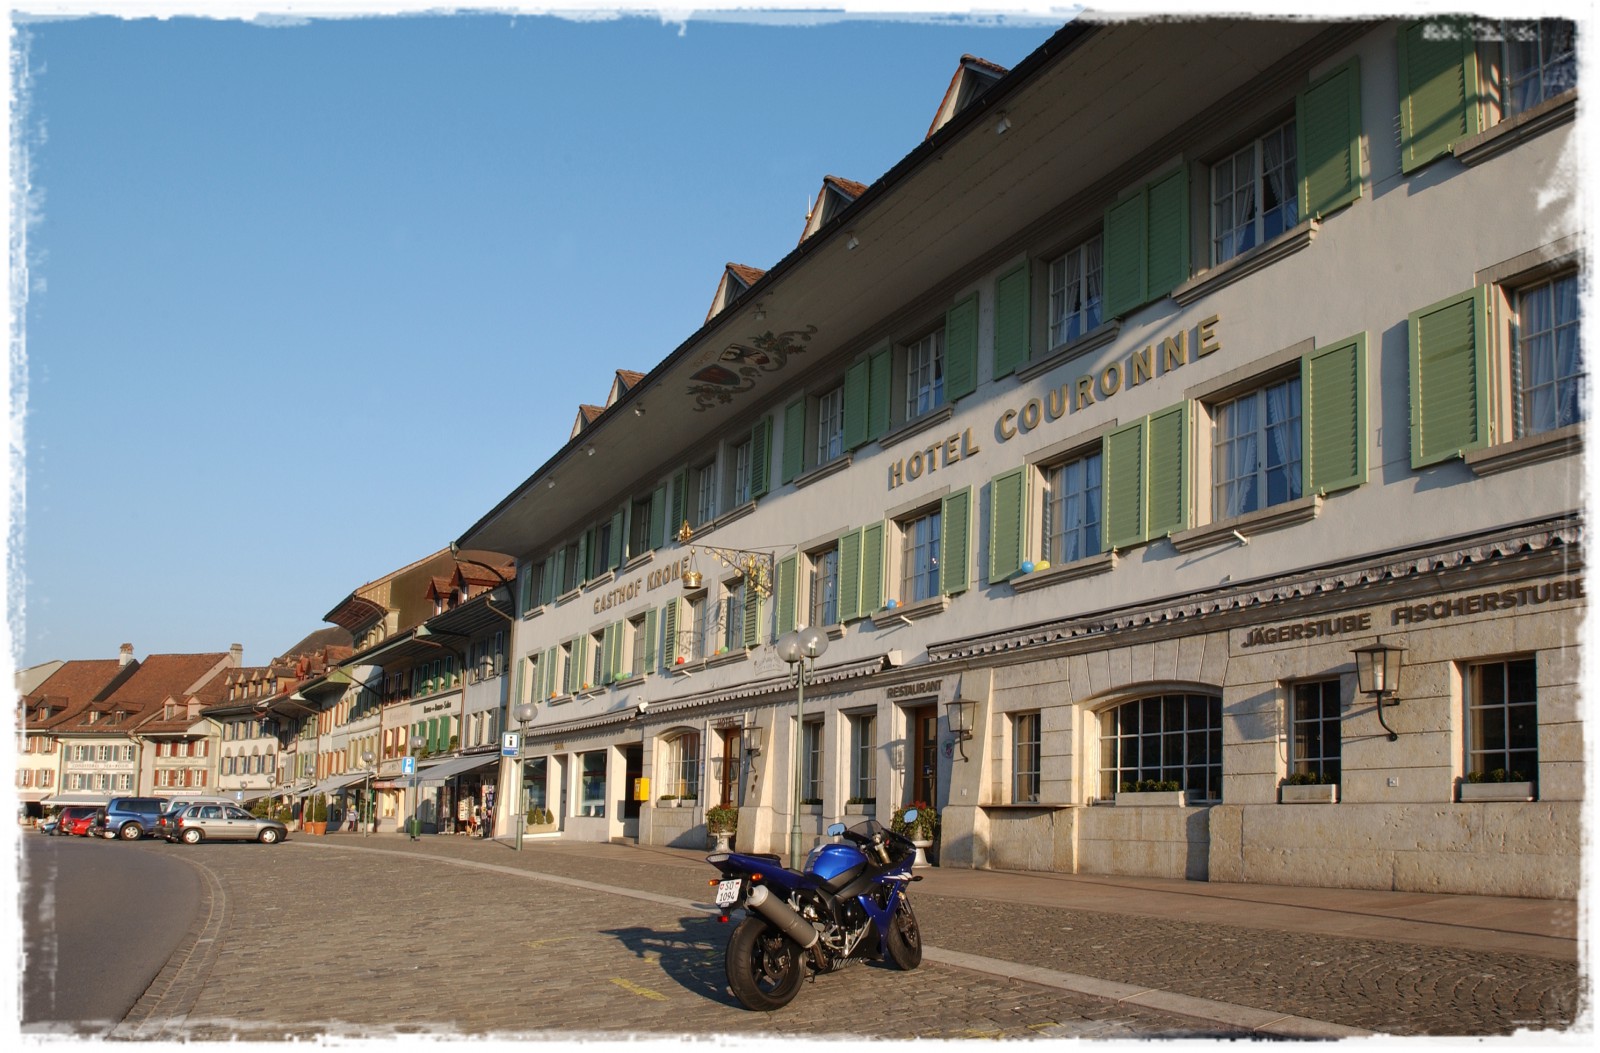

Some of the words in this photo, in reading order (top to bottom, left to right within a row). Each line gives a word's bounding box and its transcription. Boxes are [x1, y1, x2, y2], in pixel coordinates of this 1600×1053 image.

[890, 427, 979, 489] HOTEL
[1000, 314, 1221, 440] COURONNE
[593, 577, 642, 614] GASTHOF
[647, 556, 690, 592] KRONE
[1241, 612, 1371, 649] JÄGERSTUBE
[1391, 578, 1588, 627] FISCHERSTUBE
[887, 680, 943, 699] RESTAURANT
